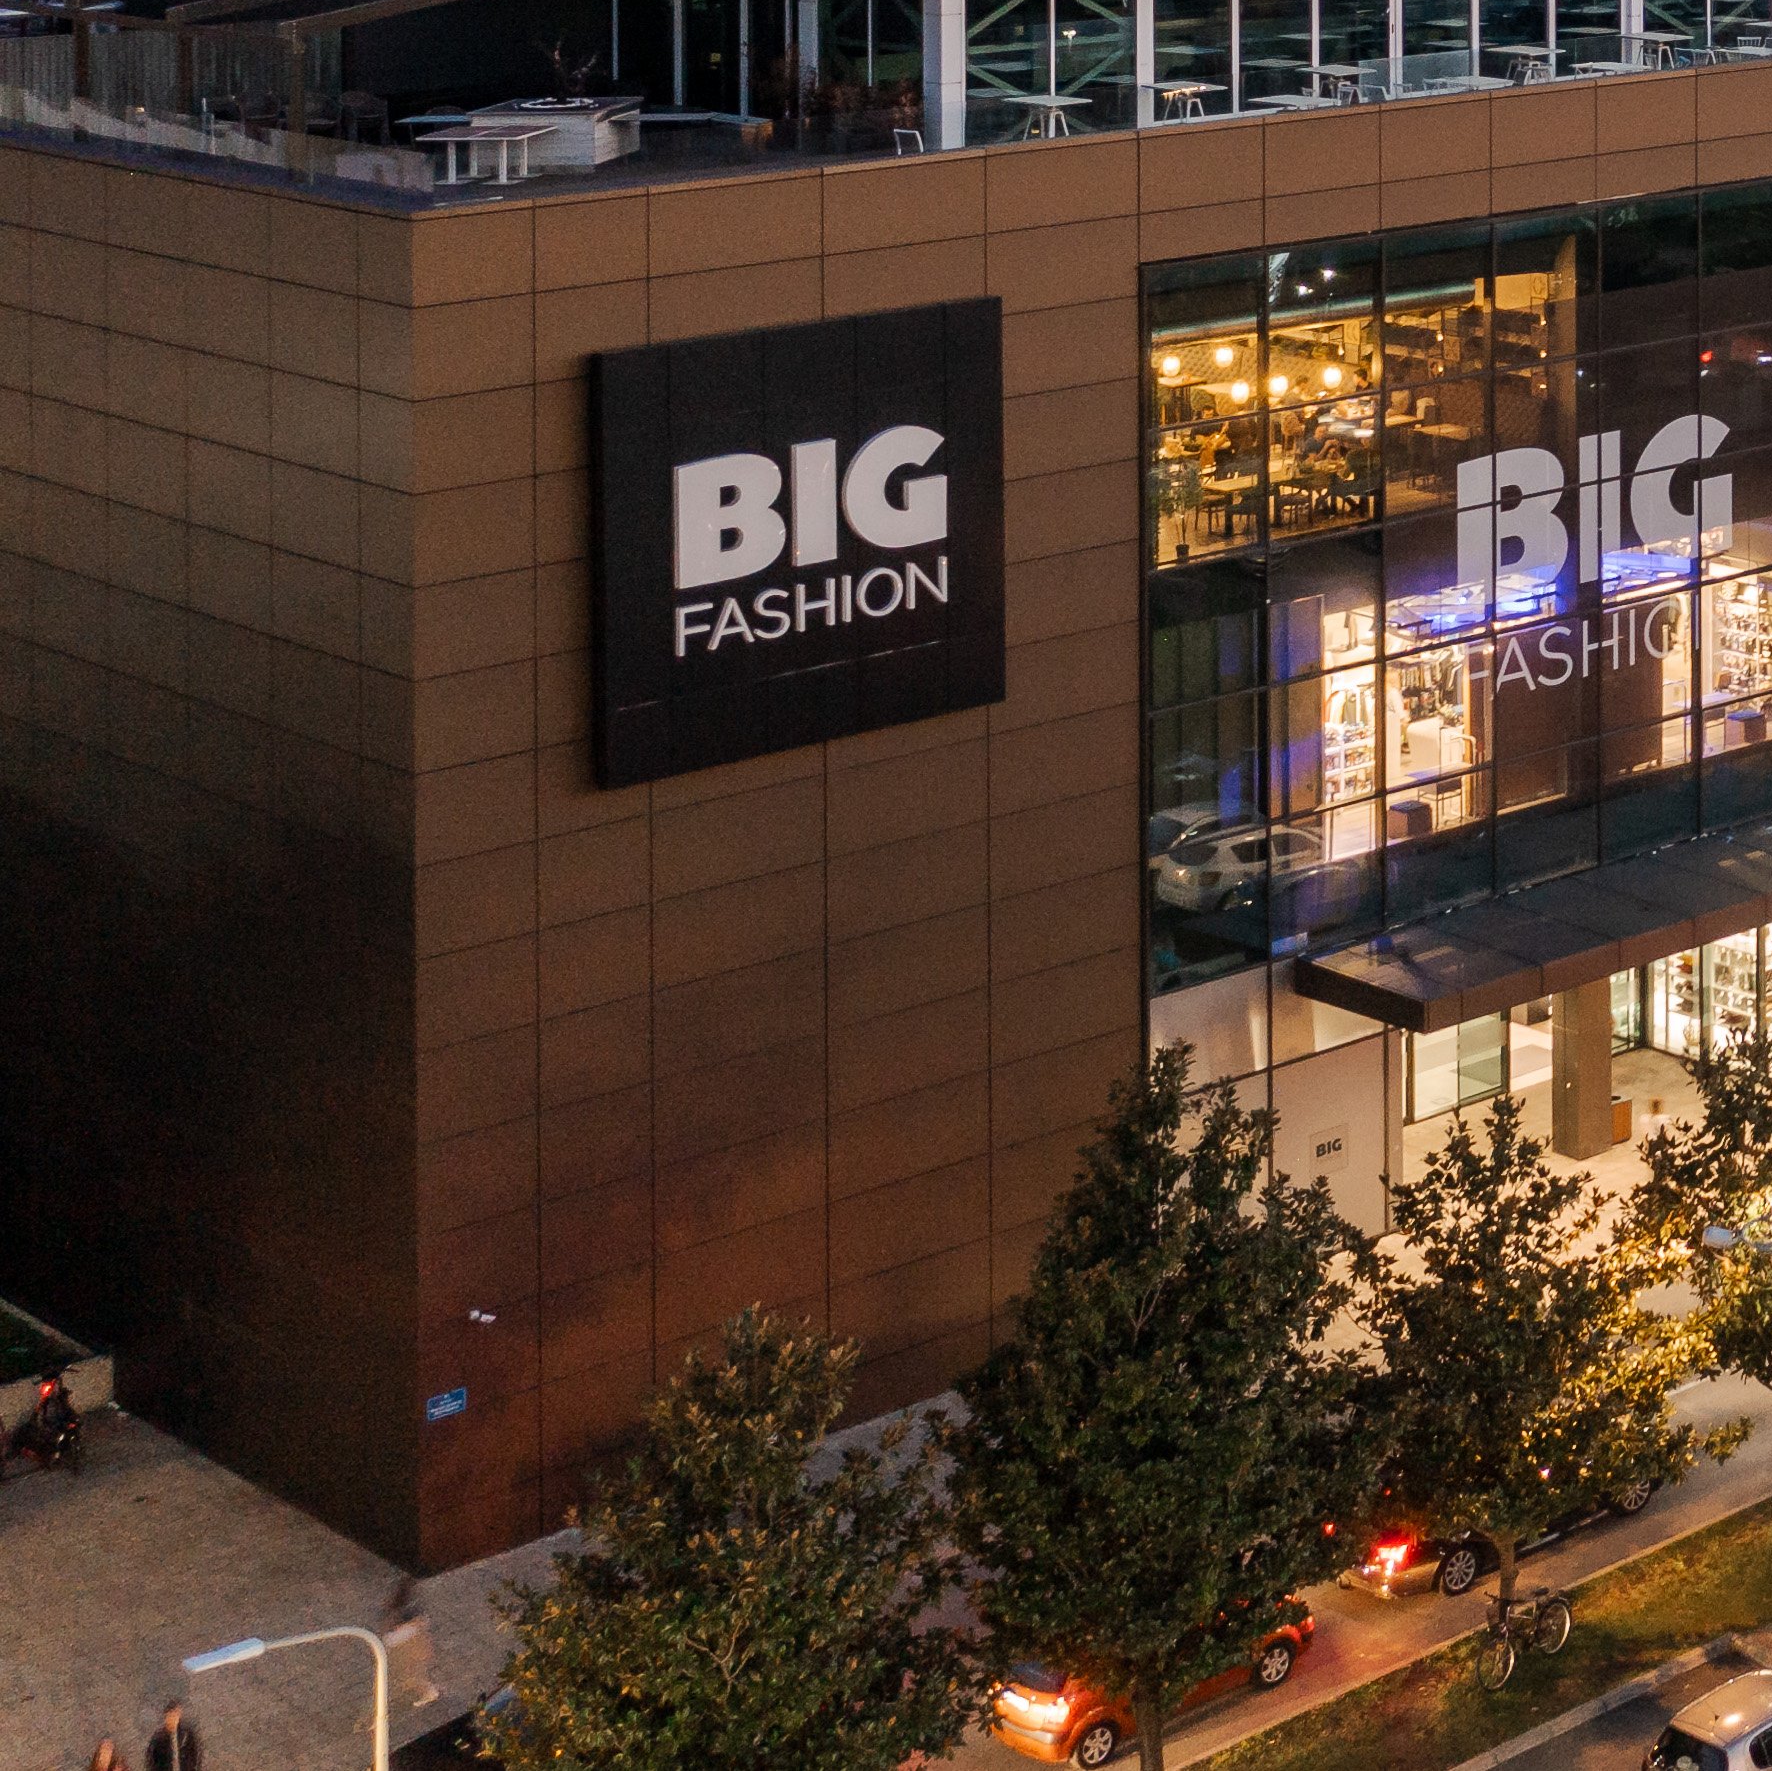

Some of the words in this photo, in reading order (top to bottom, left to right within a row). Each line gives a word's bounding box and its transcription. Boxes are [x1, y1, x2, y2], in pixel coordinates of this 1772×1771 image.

[673, 424, 948, 590] BIG
[1457, 414, 1733, 610] BIG
[675, 555, 948, 657] FASHION
[1315, 1137, 1343, 1158] BIG
